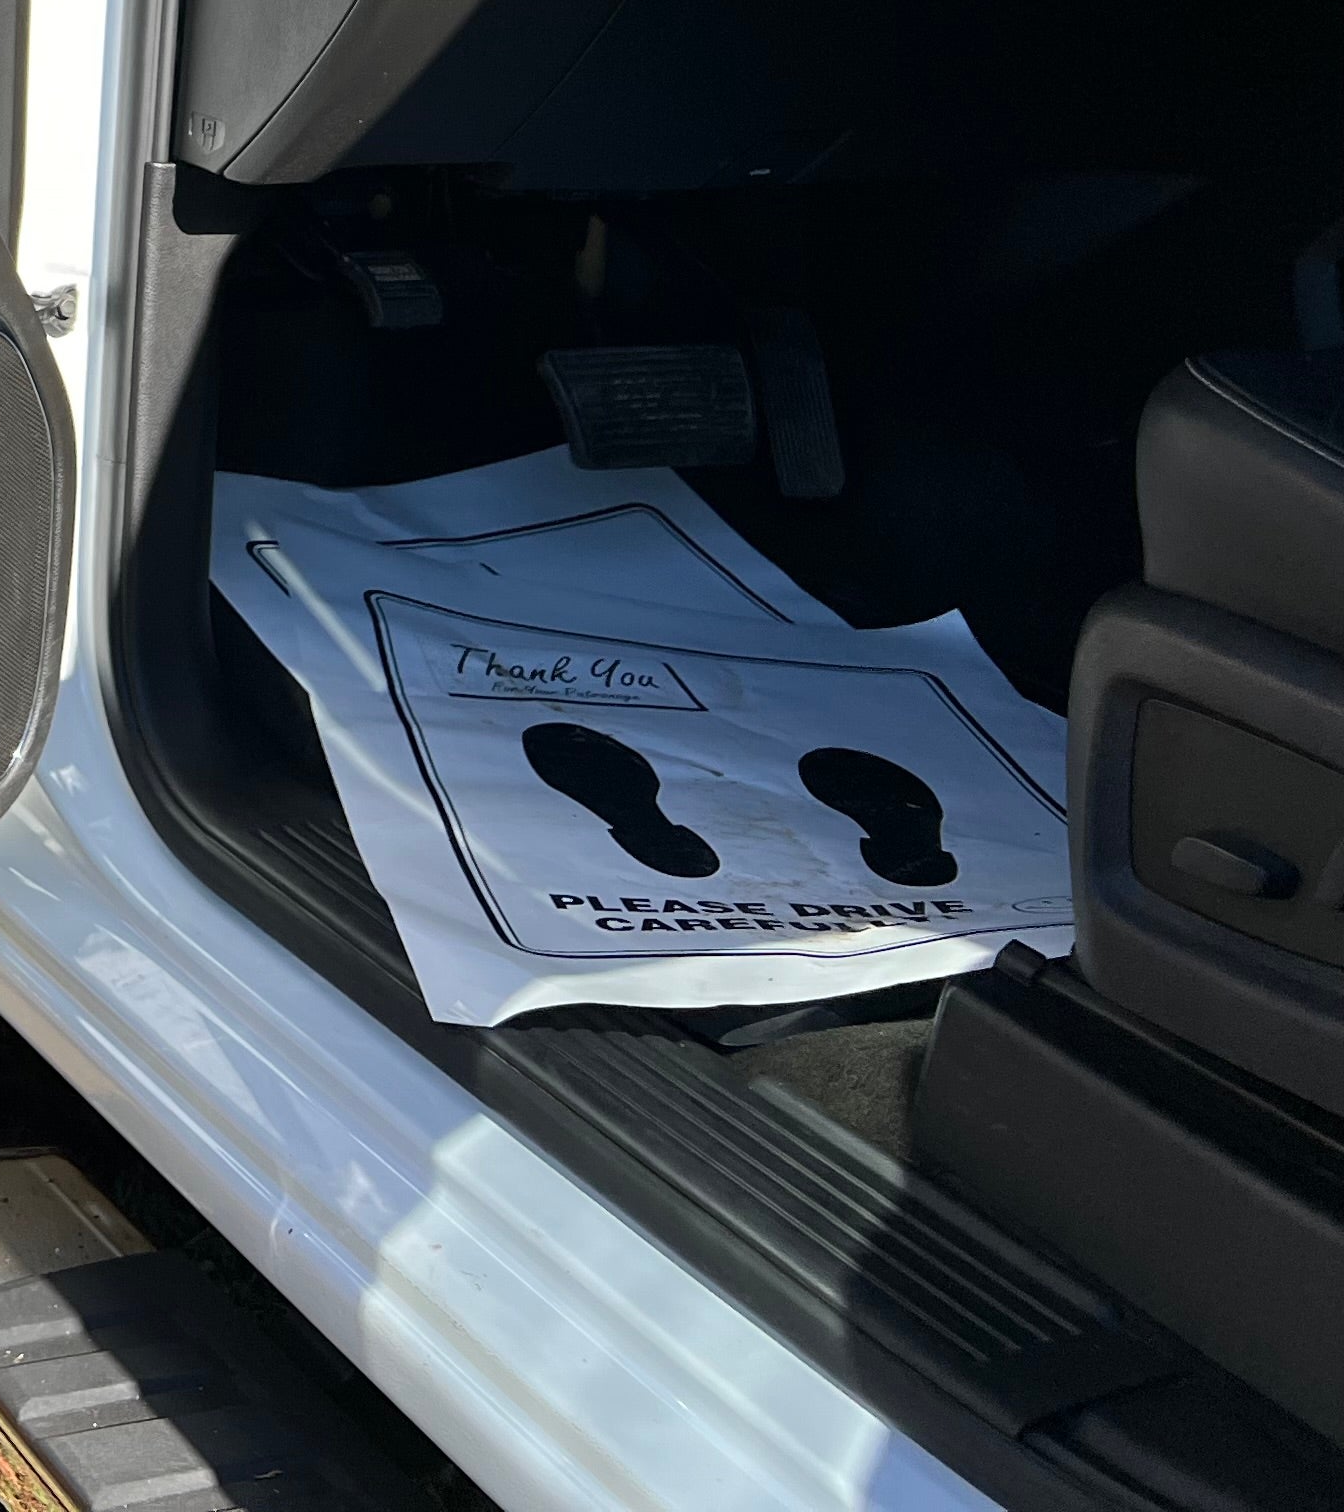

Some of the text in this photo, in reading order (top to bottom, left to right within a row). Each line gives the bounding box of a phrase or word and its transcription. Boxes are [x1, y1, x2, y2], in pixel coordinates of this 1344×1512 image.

[450, 644, 660, 688] Thank You
[549, 894, 973, 919] PLEASE DRIVE
